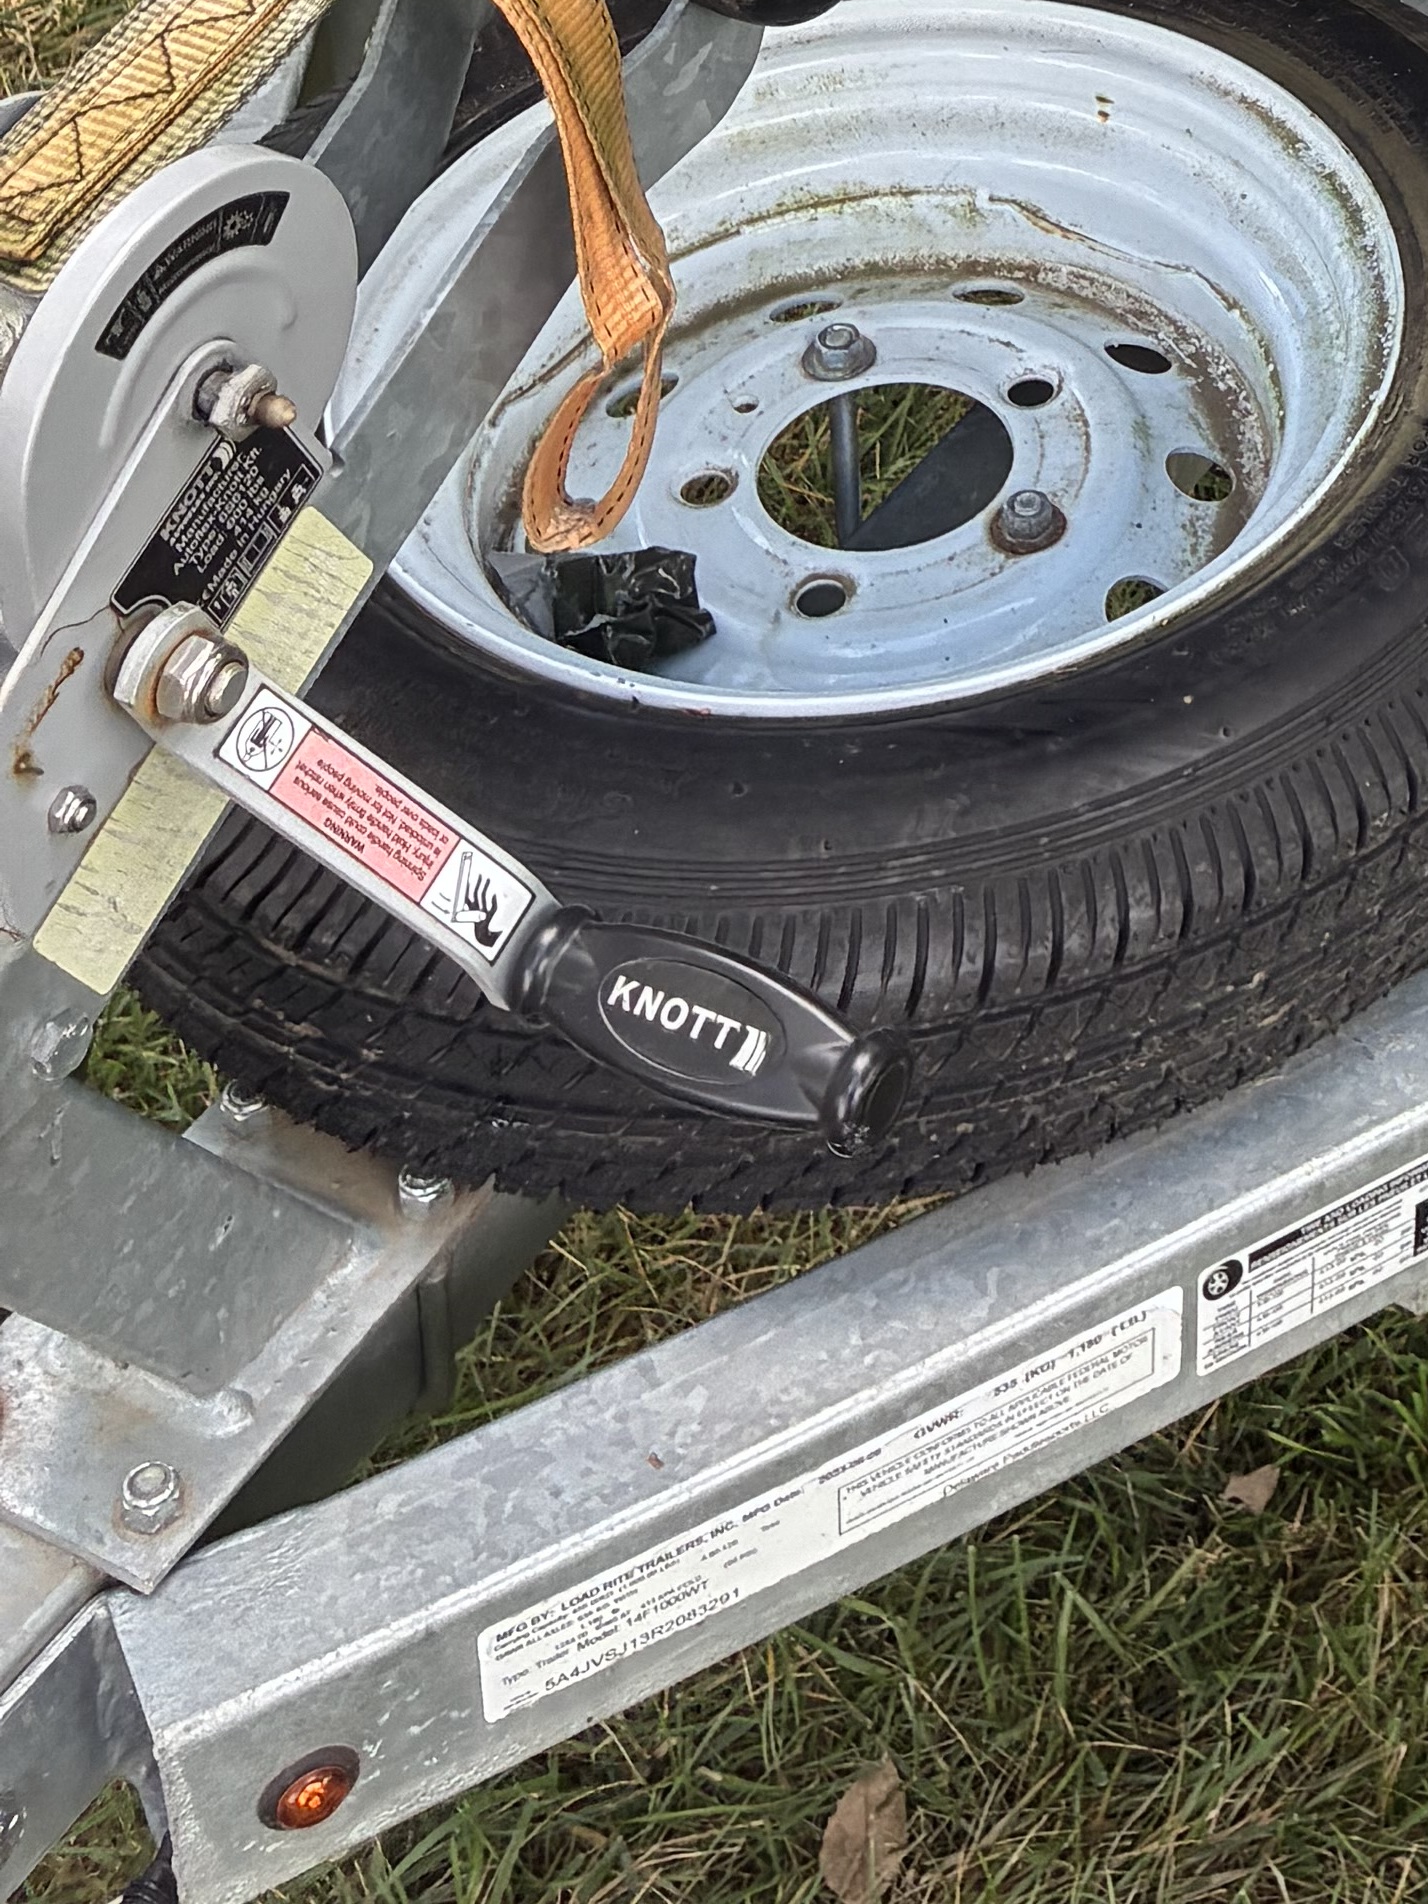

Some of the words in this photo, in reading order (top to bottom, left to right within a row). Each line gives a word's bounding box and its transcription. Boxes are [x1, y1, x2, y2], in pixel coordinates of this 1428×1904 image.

[158, 459, 217, 542] KNOTT
[206, 546, 239, 593] Made
[245, 465, 294, 533] Hungary
[320, 815, 368, 854] WARNING
[363, 829, 395, 858] handle
[389, 847, 429, 882] Spinning
[606, 974, 742, 1052] KNOTT
[495, 1620, 528, 1644] MFG
[560, 1583, 600, 1613] LOAD
[709, 1517, 739, 1540] INC.
